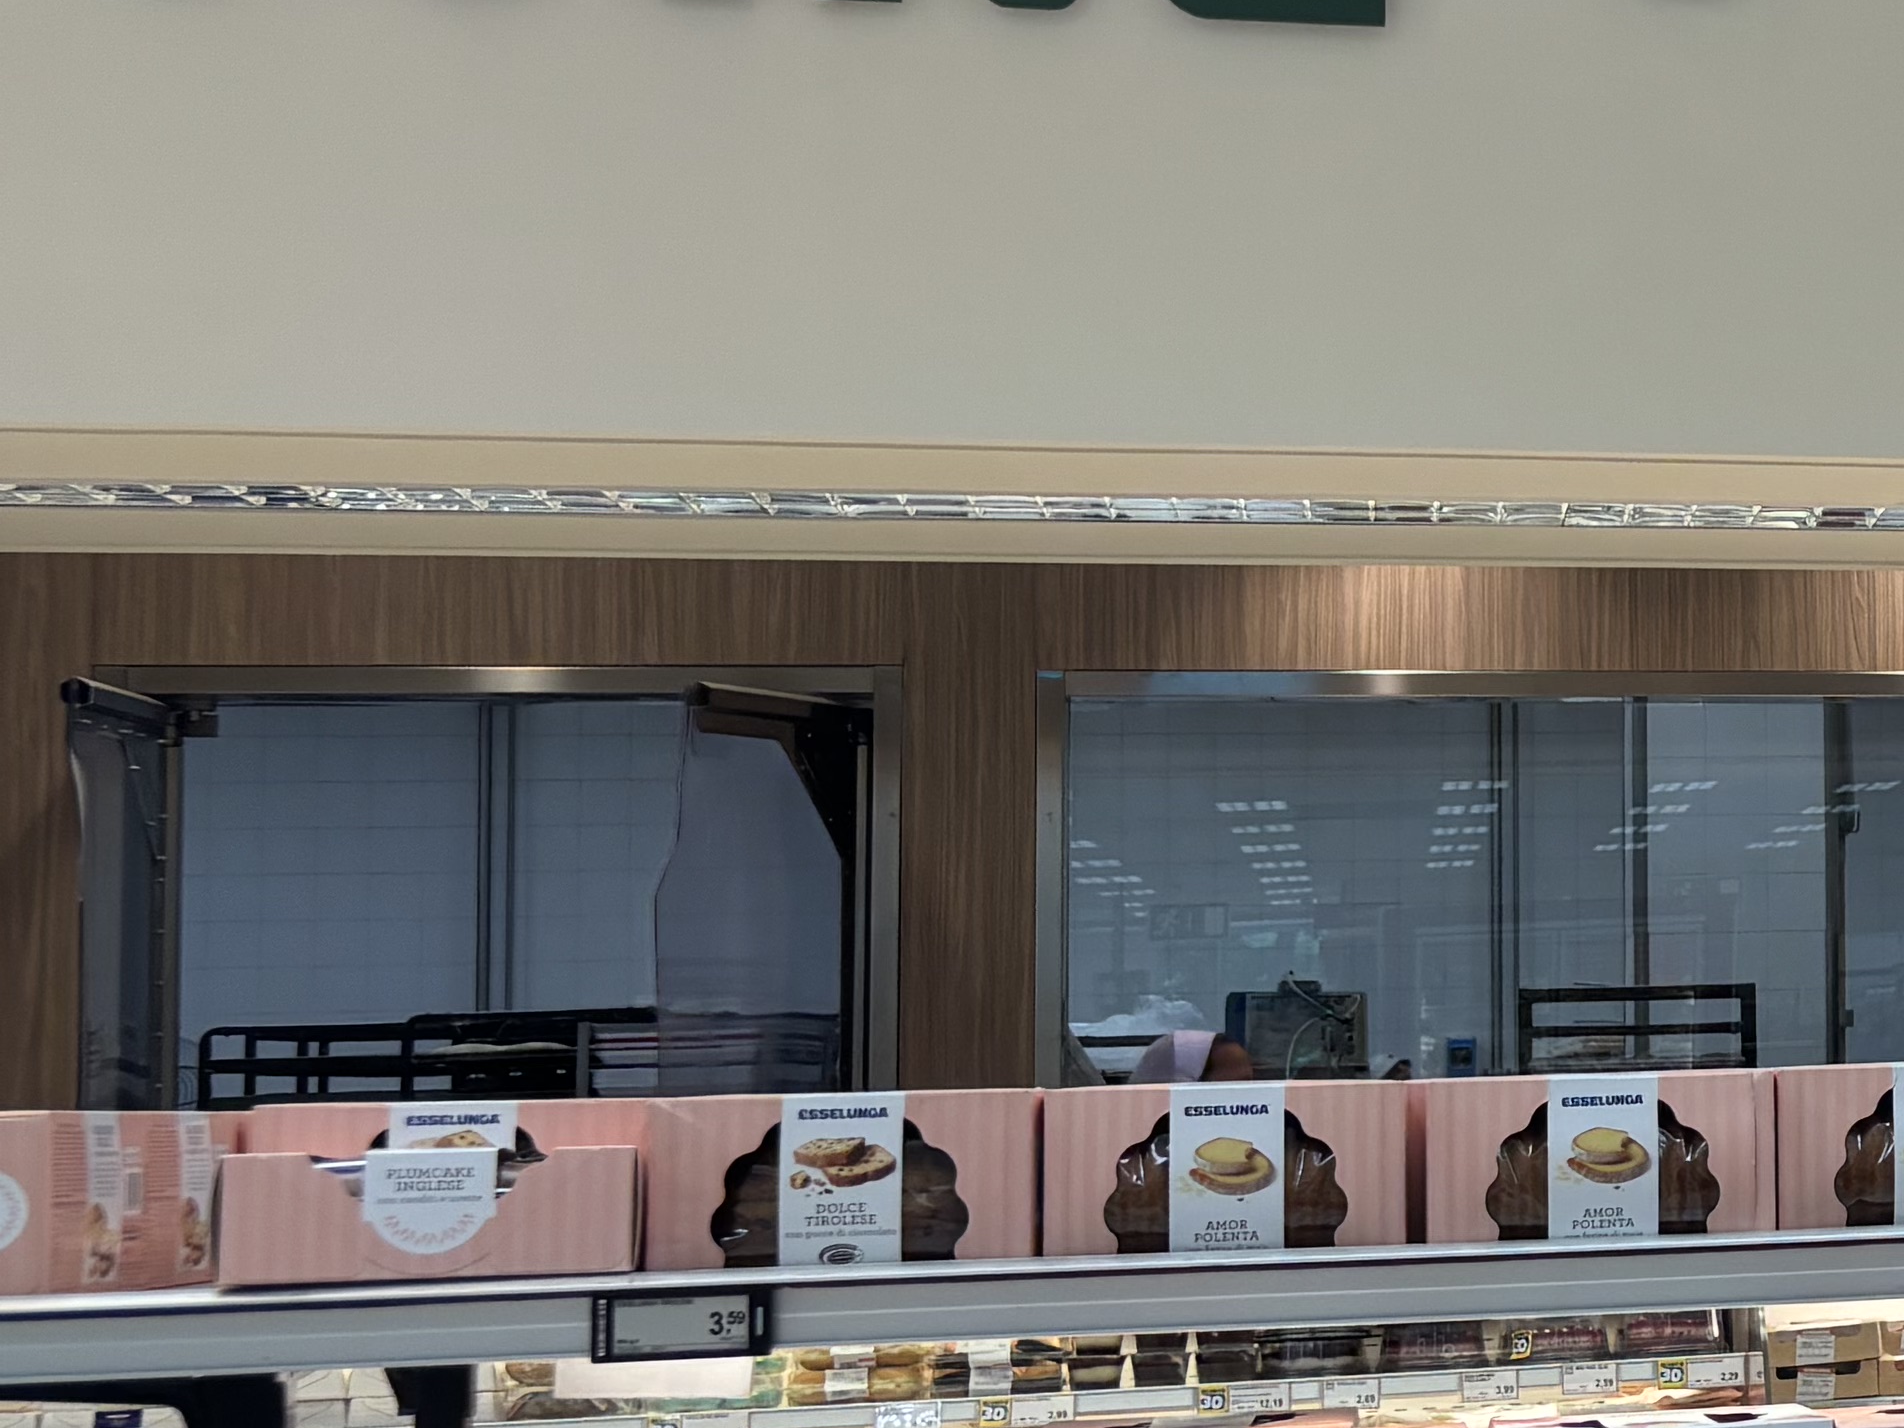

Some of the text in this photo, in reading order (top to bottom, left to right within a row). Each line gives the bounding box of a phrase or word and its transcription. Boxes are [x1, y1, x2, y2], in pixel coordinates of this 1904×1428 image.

[385, 1166, 476, 1181] PLUMCAKE
[394, 1179, 466, 1193] INGLESE
[815, 1202, 867, 1214] DOLCE
[1583, 1207, 1624, 1218] AMOR
[804, 1214, 876, 1227] TIROLESE
[1206, 1220, 1248, 1230] AMOR
[1572, 1218, 1635, 1230] POLENTA
[1194, 1230, 1260, 1243] POLENTA
